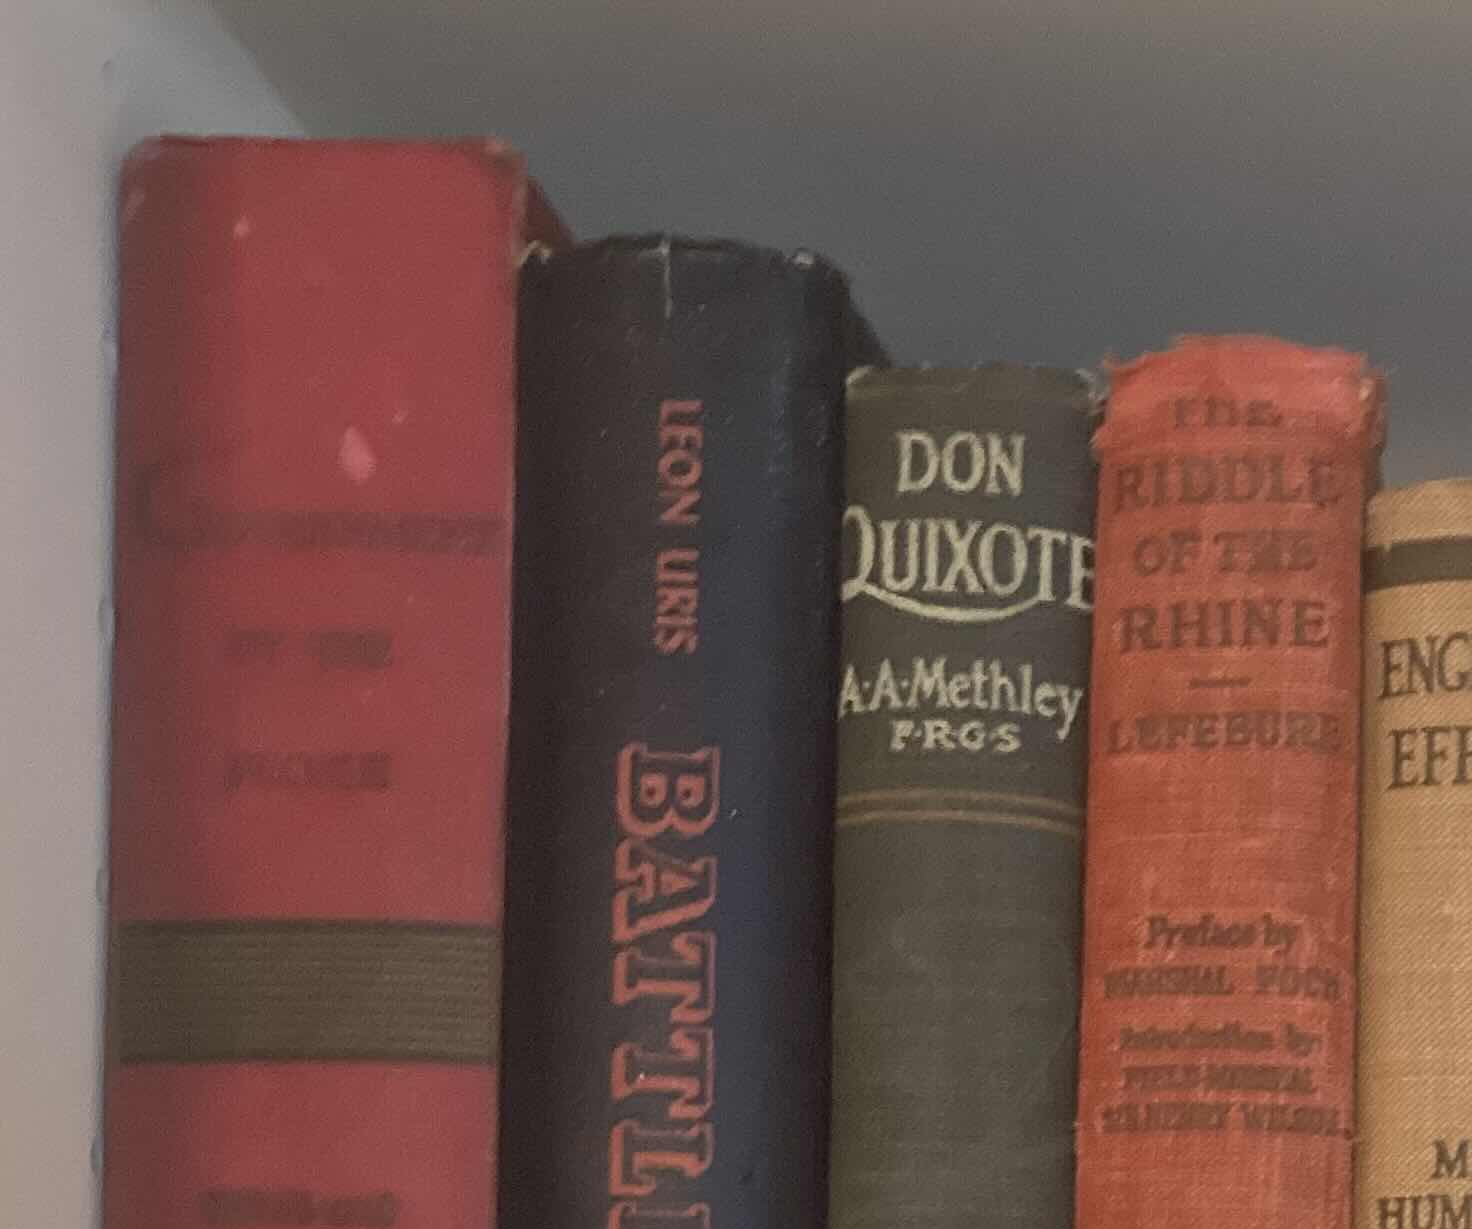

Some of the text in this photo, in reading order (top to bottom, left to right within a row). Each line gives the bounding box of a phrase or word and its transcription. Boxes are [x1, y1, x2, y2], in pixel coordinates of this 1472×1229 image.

[896, 429, 1027, 497] DON
[1113, 456, 1345, 516] RIDDLE
[654, 399, 704, 656] LEON URIS
[1132, 528, 1318, 577] OF THE
[1119, 600, 1330, 655] RHINE
